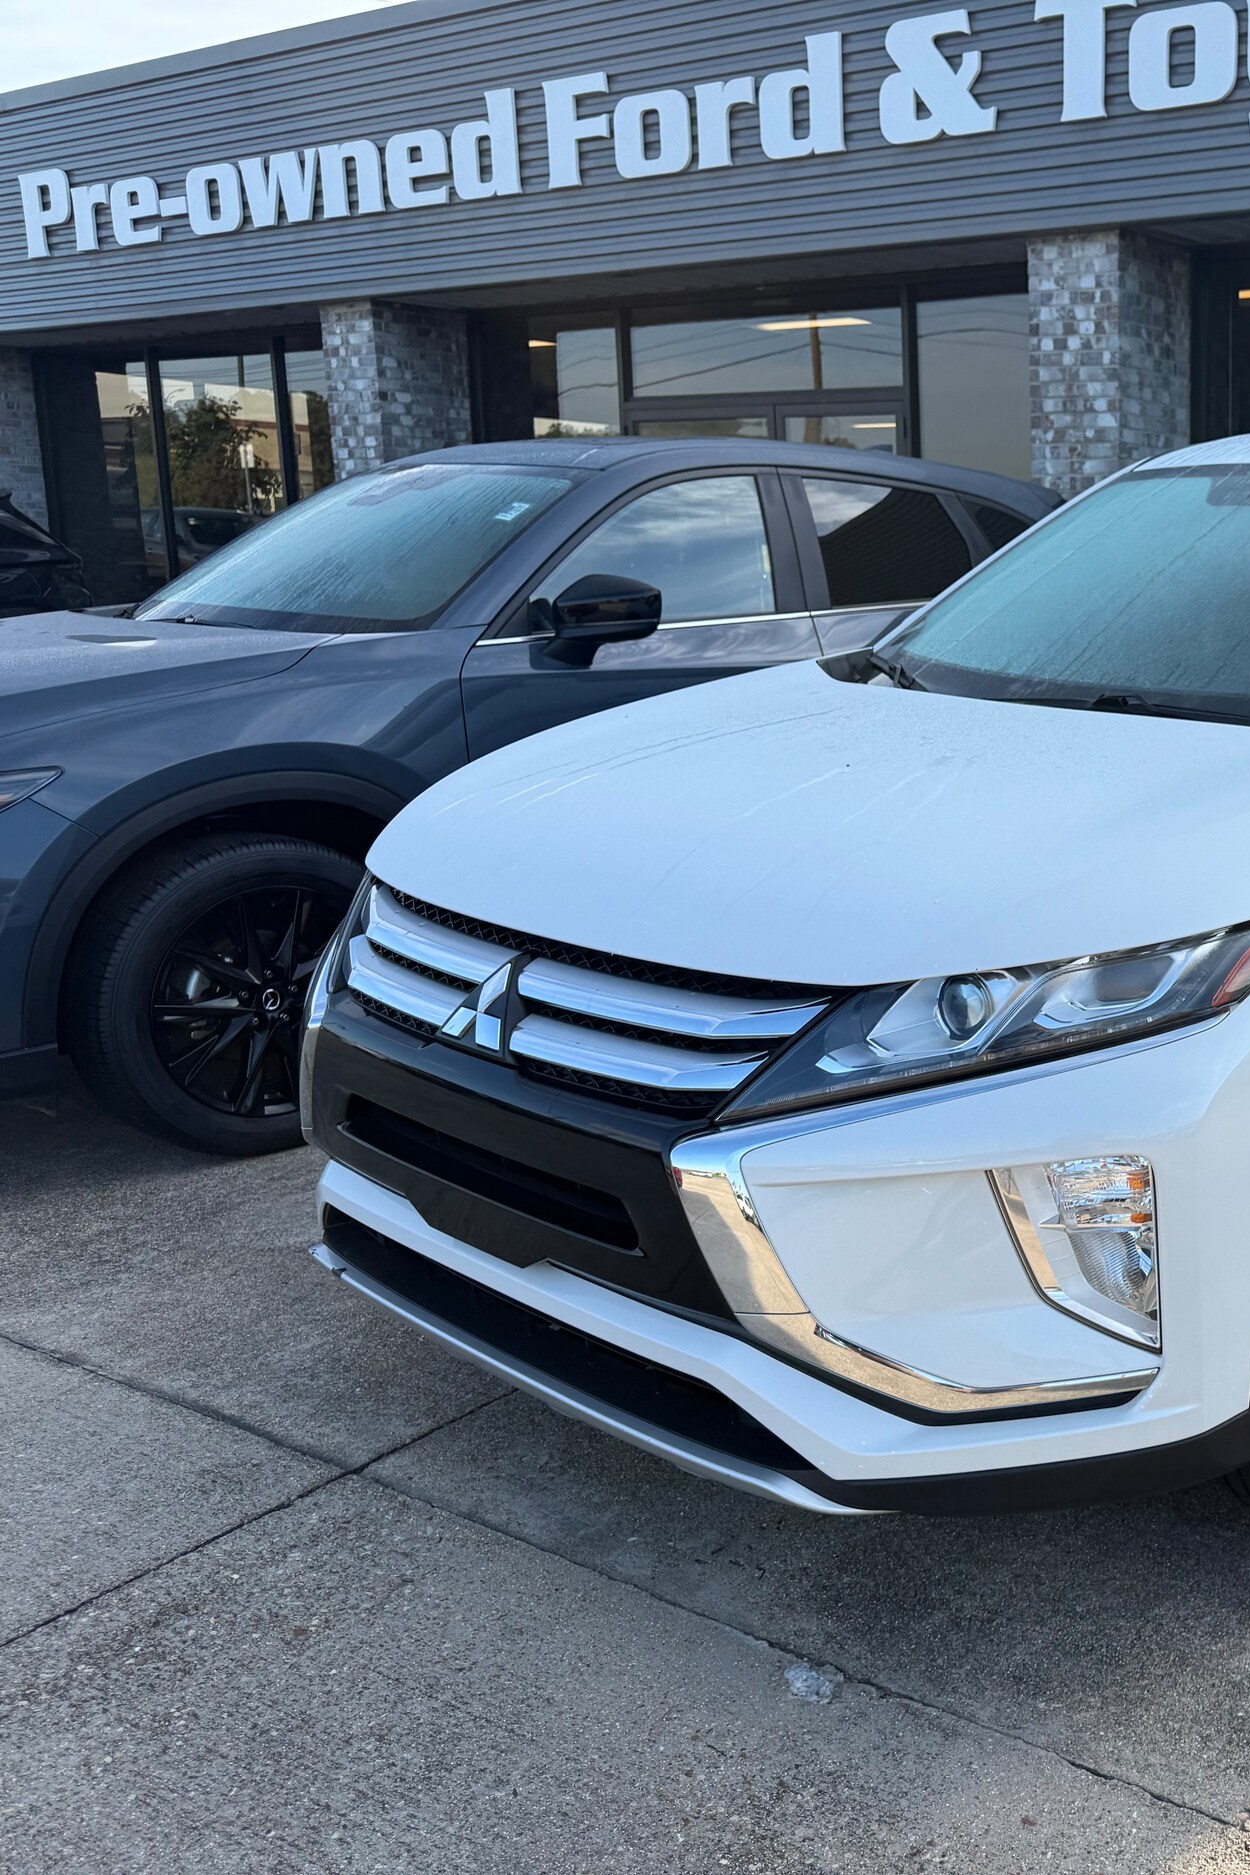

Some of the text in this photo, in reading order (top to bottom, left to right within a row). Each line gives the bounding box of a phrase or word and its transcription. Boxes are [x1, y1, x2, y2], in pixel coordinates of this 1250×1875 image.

[18, 88, 523, 259] Pre-owned
[542, 31, 846, 189] Ford
[879, 8, 998, 145] &
